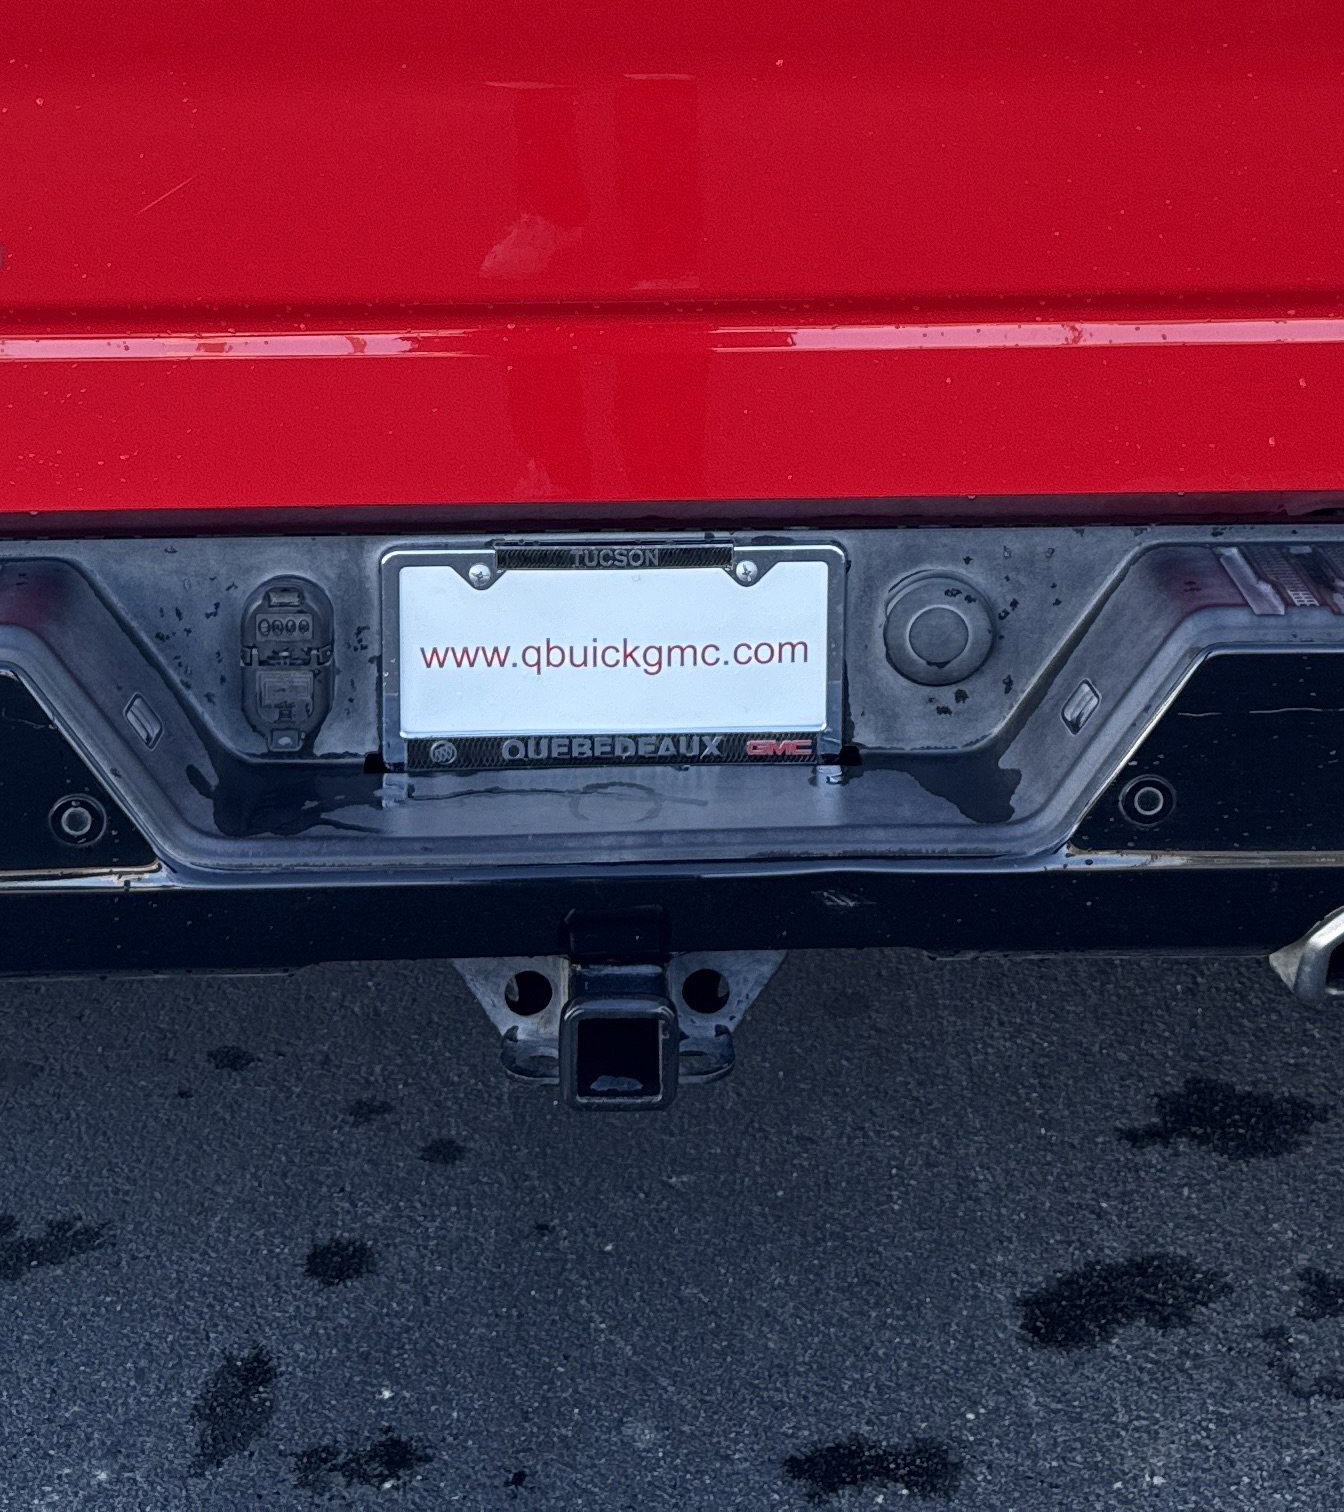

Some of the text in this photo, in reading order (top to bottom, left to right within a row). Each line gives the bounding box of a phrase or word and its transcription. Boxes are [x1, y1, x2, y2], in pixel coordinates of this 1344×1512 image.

[572, 548, 659, 568] TUCSON
[420, 637, 808, 676] www.qbuickgmc.com
[501, 735, 813, 761] QUEBEDEAUX GMC
